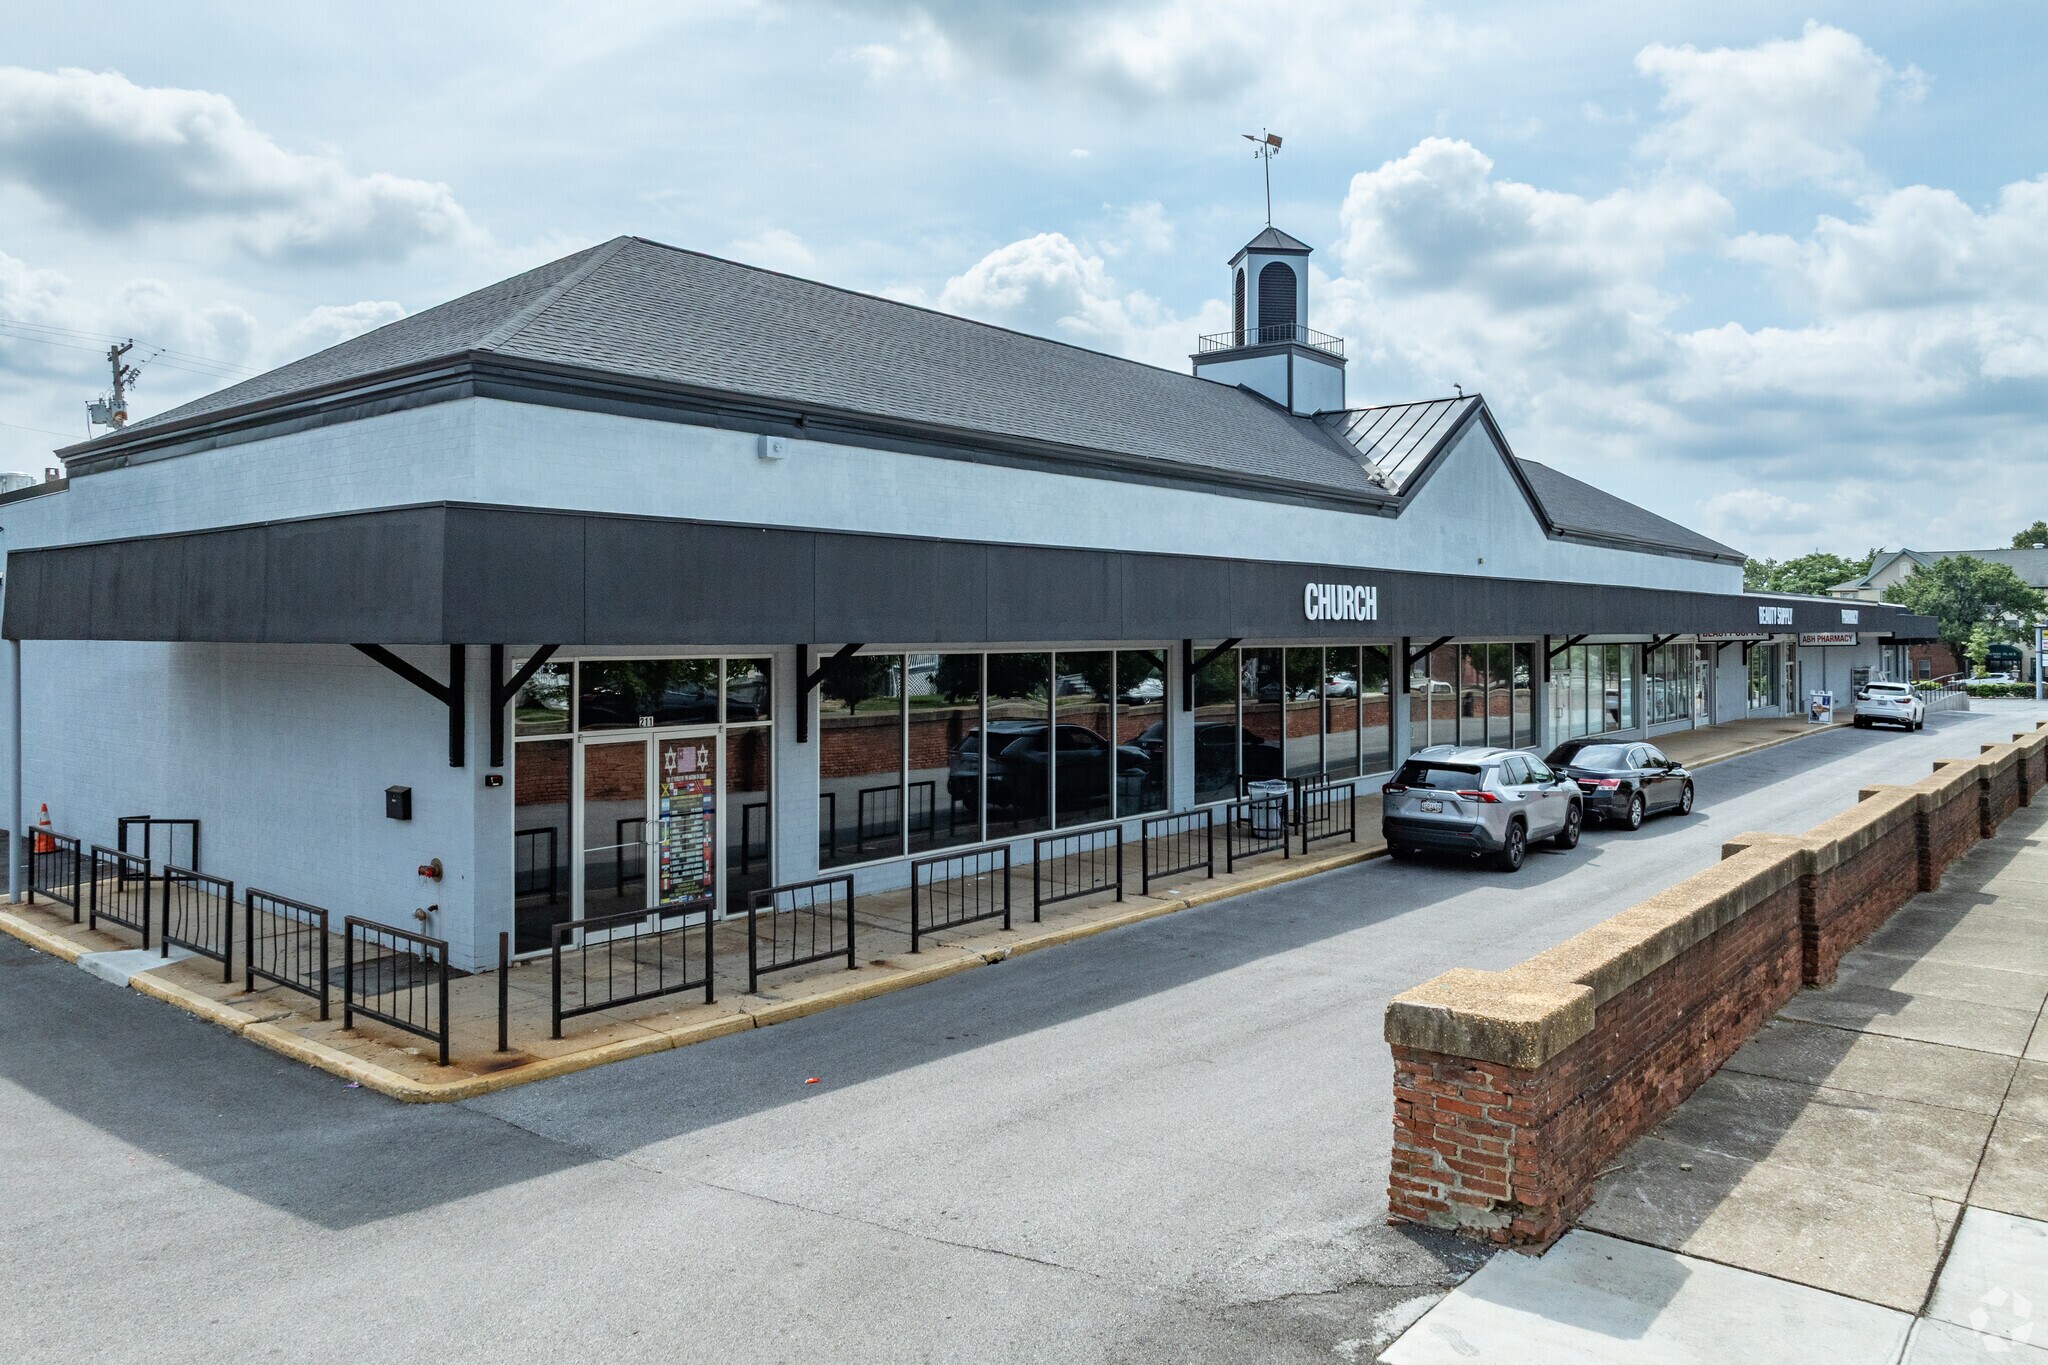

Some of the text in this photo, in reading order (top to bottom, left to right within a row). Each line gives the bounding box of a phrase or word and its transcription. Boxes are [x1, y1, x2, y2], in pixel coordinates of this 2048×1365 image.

[1304, 582, 1377, 621] CHURCH
[1776, 607, 1793, 625] SUPPLY
[1802, 634, 1853, 643] ABH PHARMACY
[639, 717, 653, 727] 211
